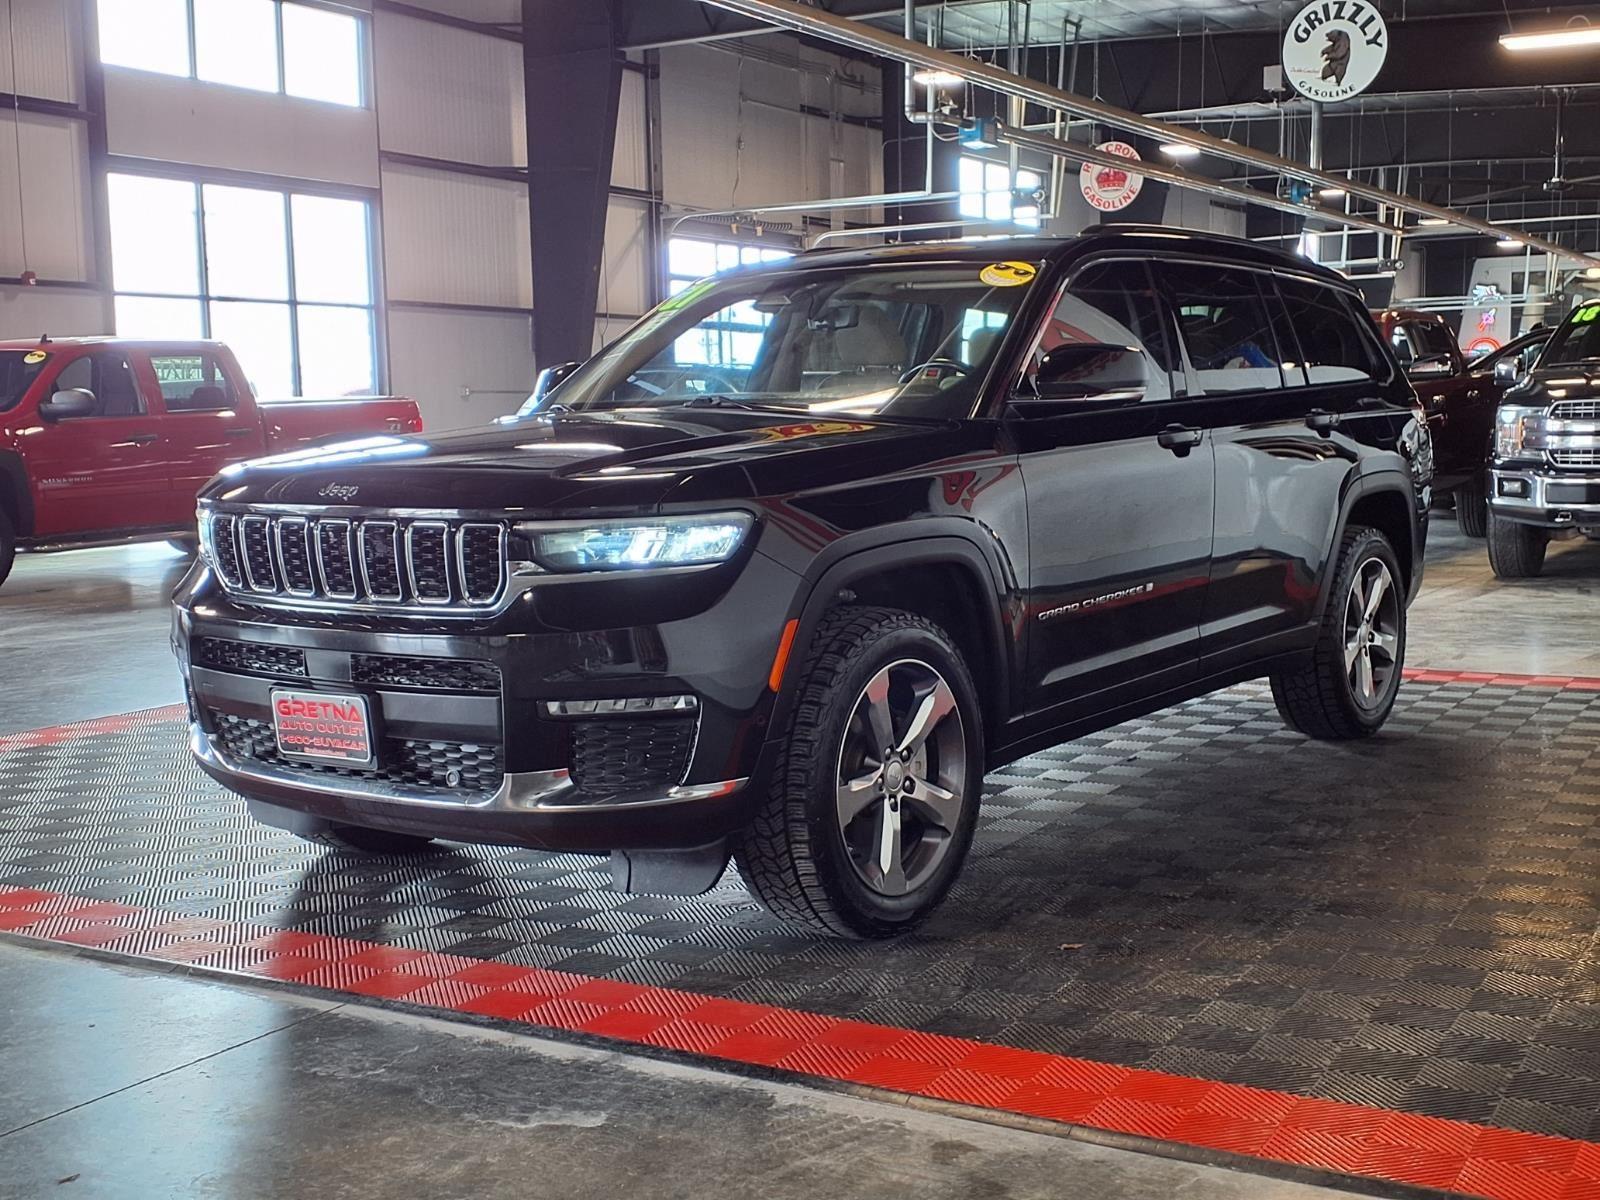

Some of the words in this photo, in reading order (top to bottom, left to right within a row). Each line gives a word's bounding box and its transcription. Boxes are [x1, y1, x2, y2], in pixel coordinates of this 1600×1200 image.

[1293, 0, 1383, 49] GRIZZLY
[1298, 80, 1356, 98] GASOLINE
[1083, 185, 1138, 210] GASOLINE
[318, 481, 360, 502] Jeep
[1038, 602, 1079, 620] GRAND
[1082, 585, 1144, 607] CHEROKEE
[277, 699, 363, 723] GRETNA
[279, 720, 313, 731] AUTO
[317, 725, 365, 736] OUTLET
